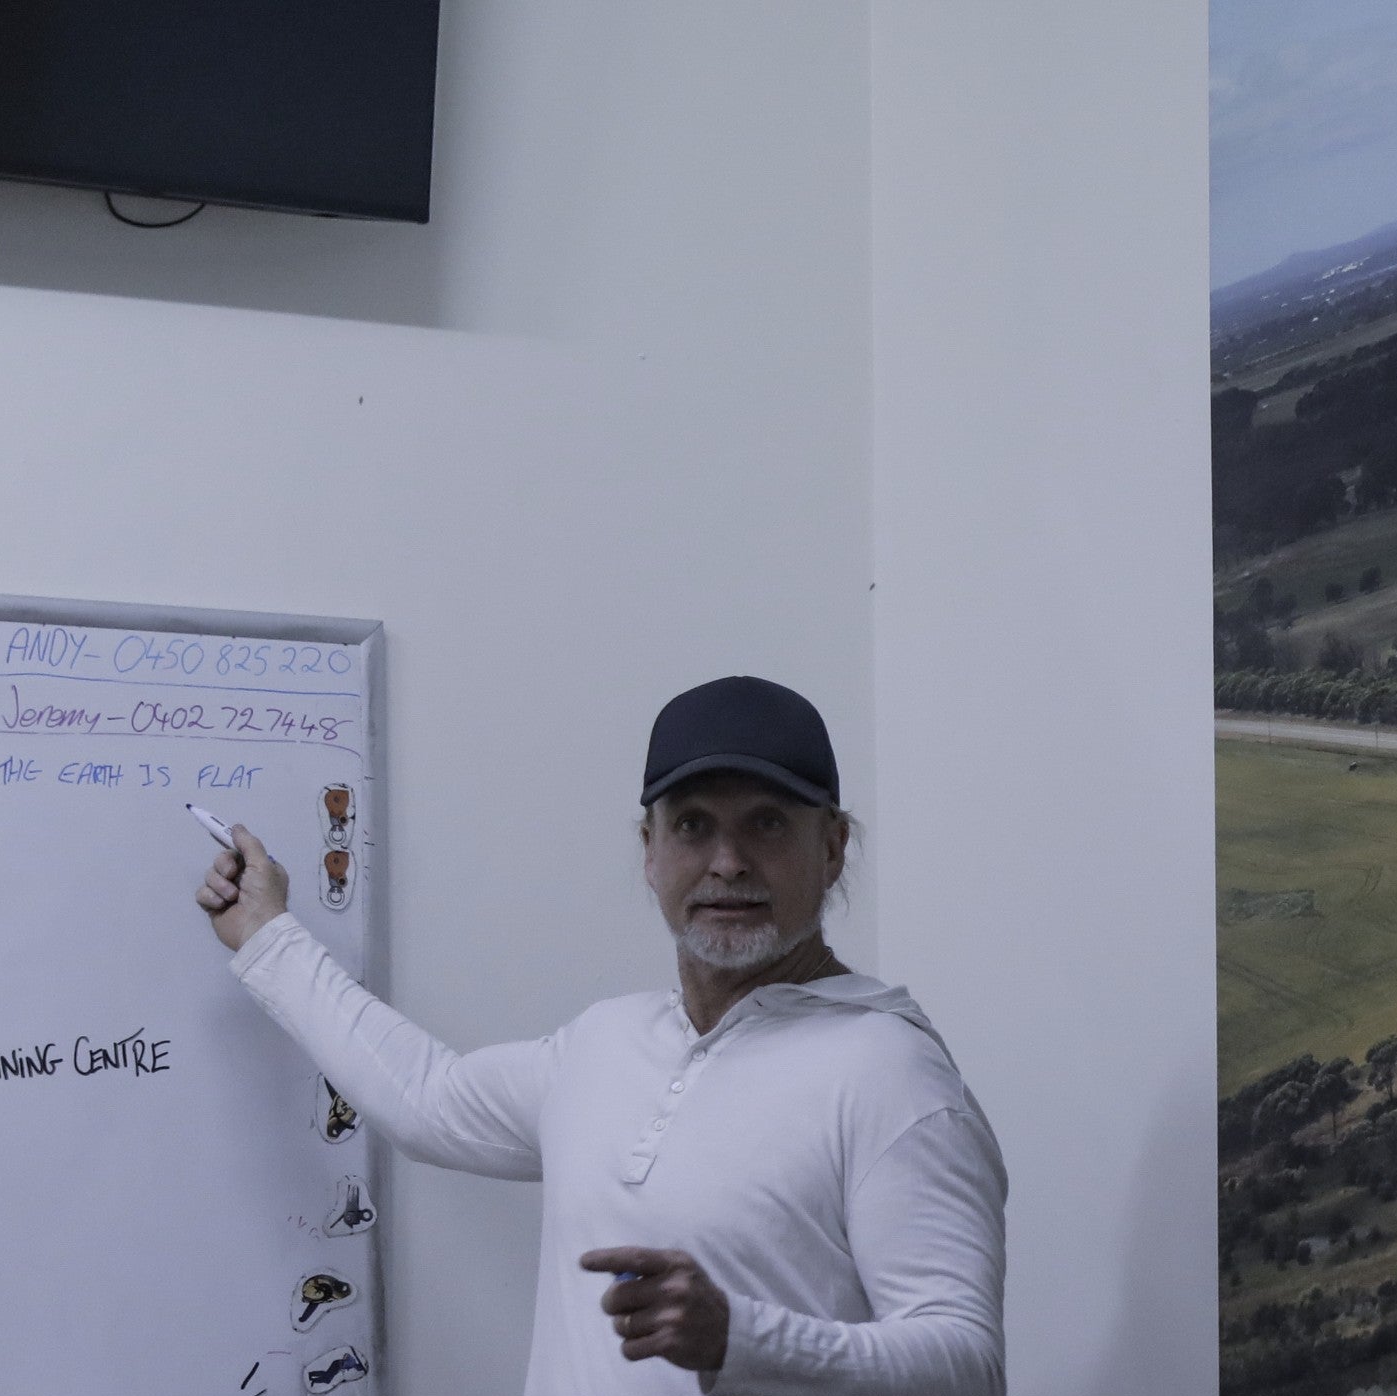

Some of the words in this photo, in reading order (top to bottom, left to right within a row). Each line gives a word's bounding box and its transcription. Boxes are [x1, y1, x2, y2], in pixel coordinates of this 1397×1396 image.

[58, 762, 125, 789] EARTH
[139, 764, 172, 787] IS
[198, 764, 264, 790] FLAT
[74, 1027, 172, 1078] CENTRE
